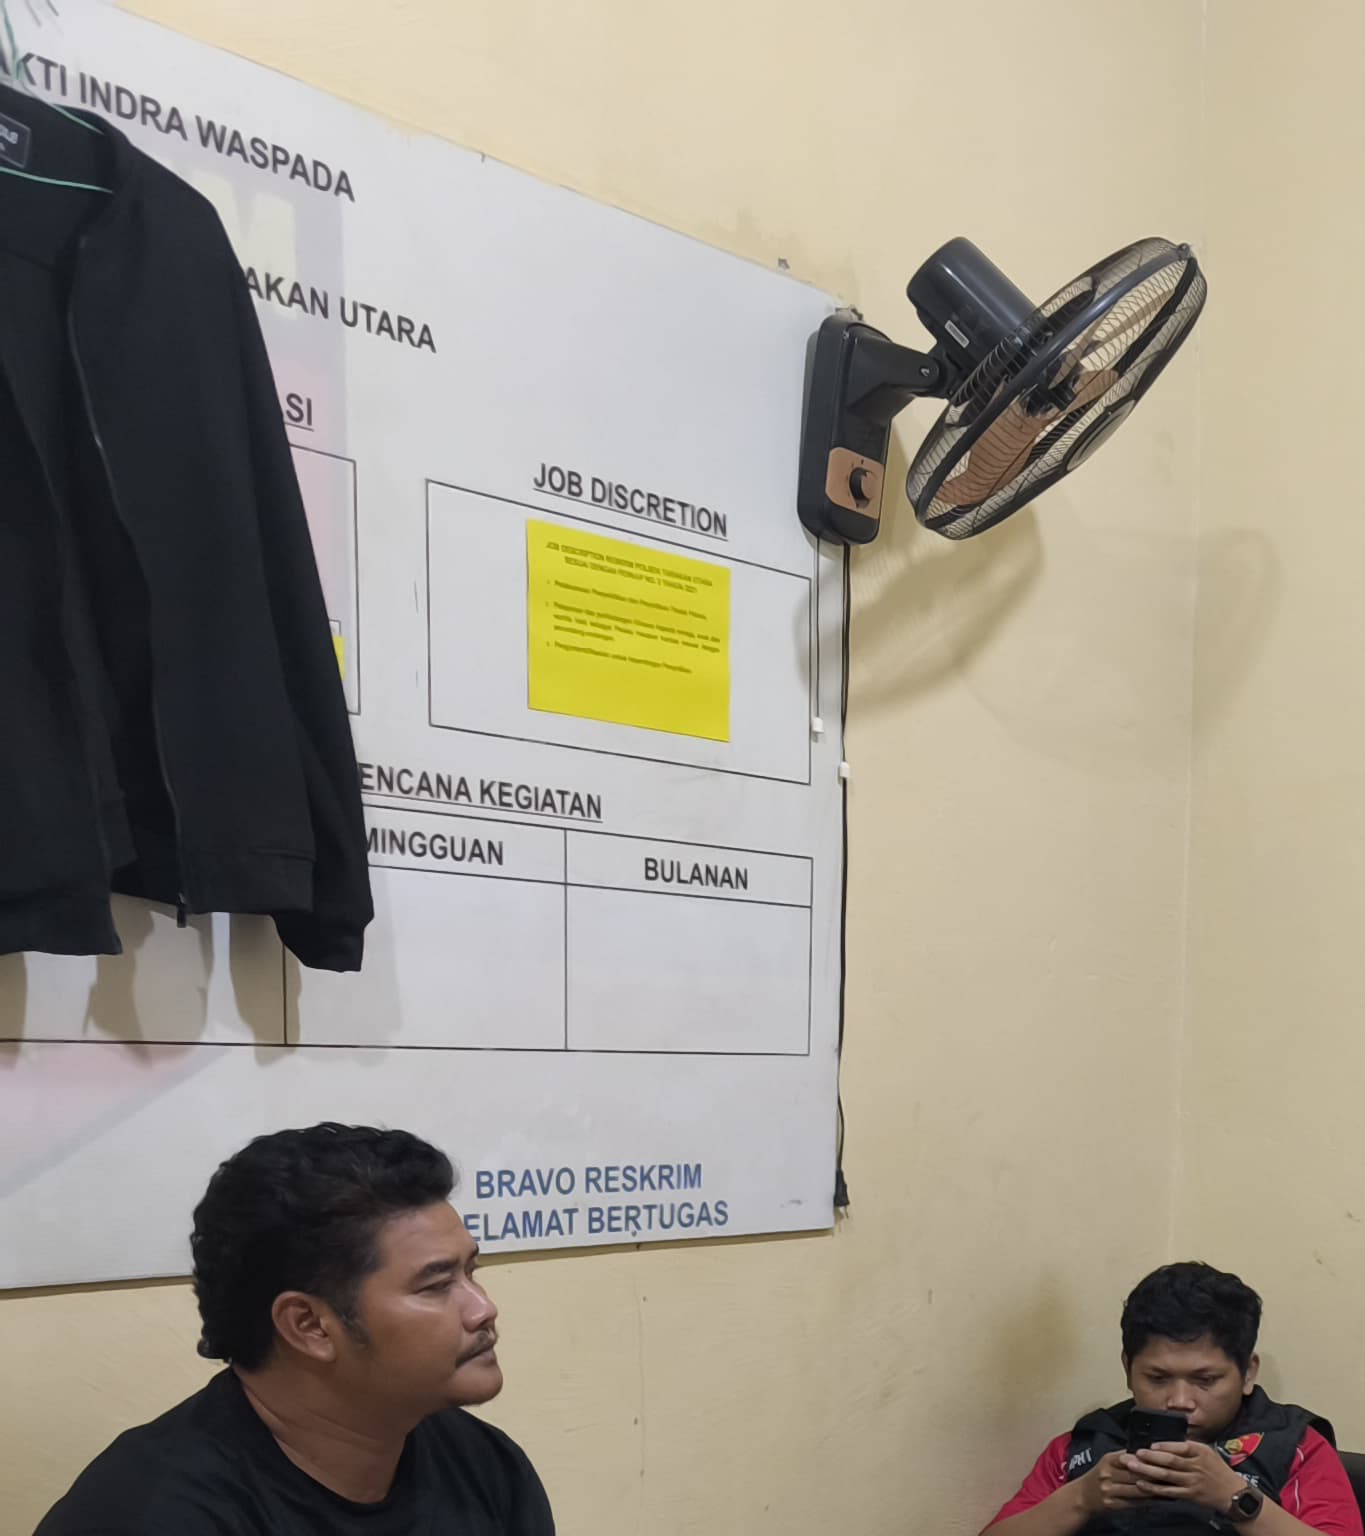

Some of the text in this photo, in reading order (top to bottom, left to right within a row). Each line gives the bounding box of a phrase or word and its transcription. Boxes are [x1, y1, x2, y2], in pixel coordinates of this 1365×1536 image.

[78, 72, 188, 141] INDRA
[195, 115, 356, 203] WASPADA
[339, 295, 437, 354] UTARA
[533, 463, 728, 538] JOB DISCRETION
[479, 779, 602, 820] KEGIATAN
[643, 857, 749, 891] BULANAN
[475, 1163, 702, 1199] BRAVO RESKRIM
[586, 1200, 729, 1234] BERTUGAS
